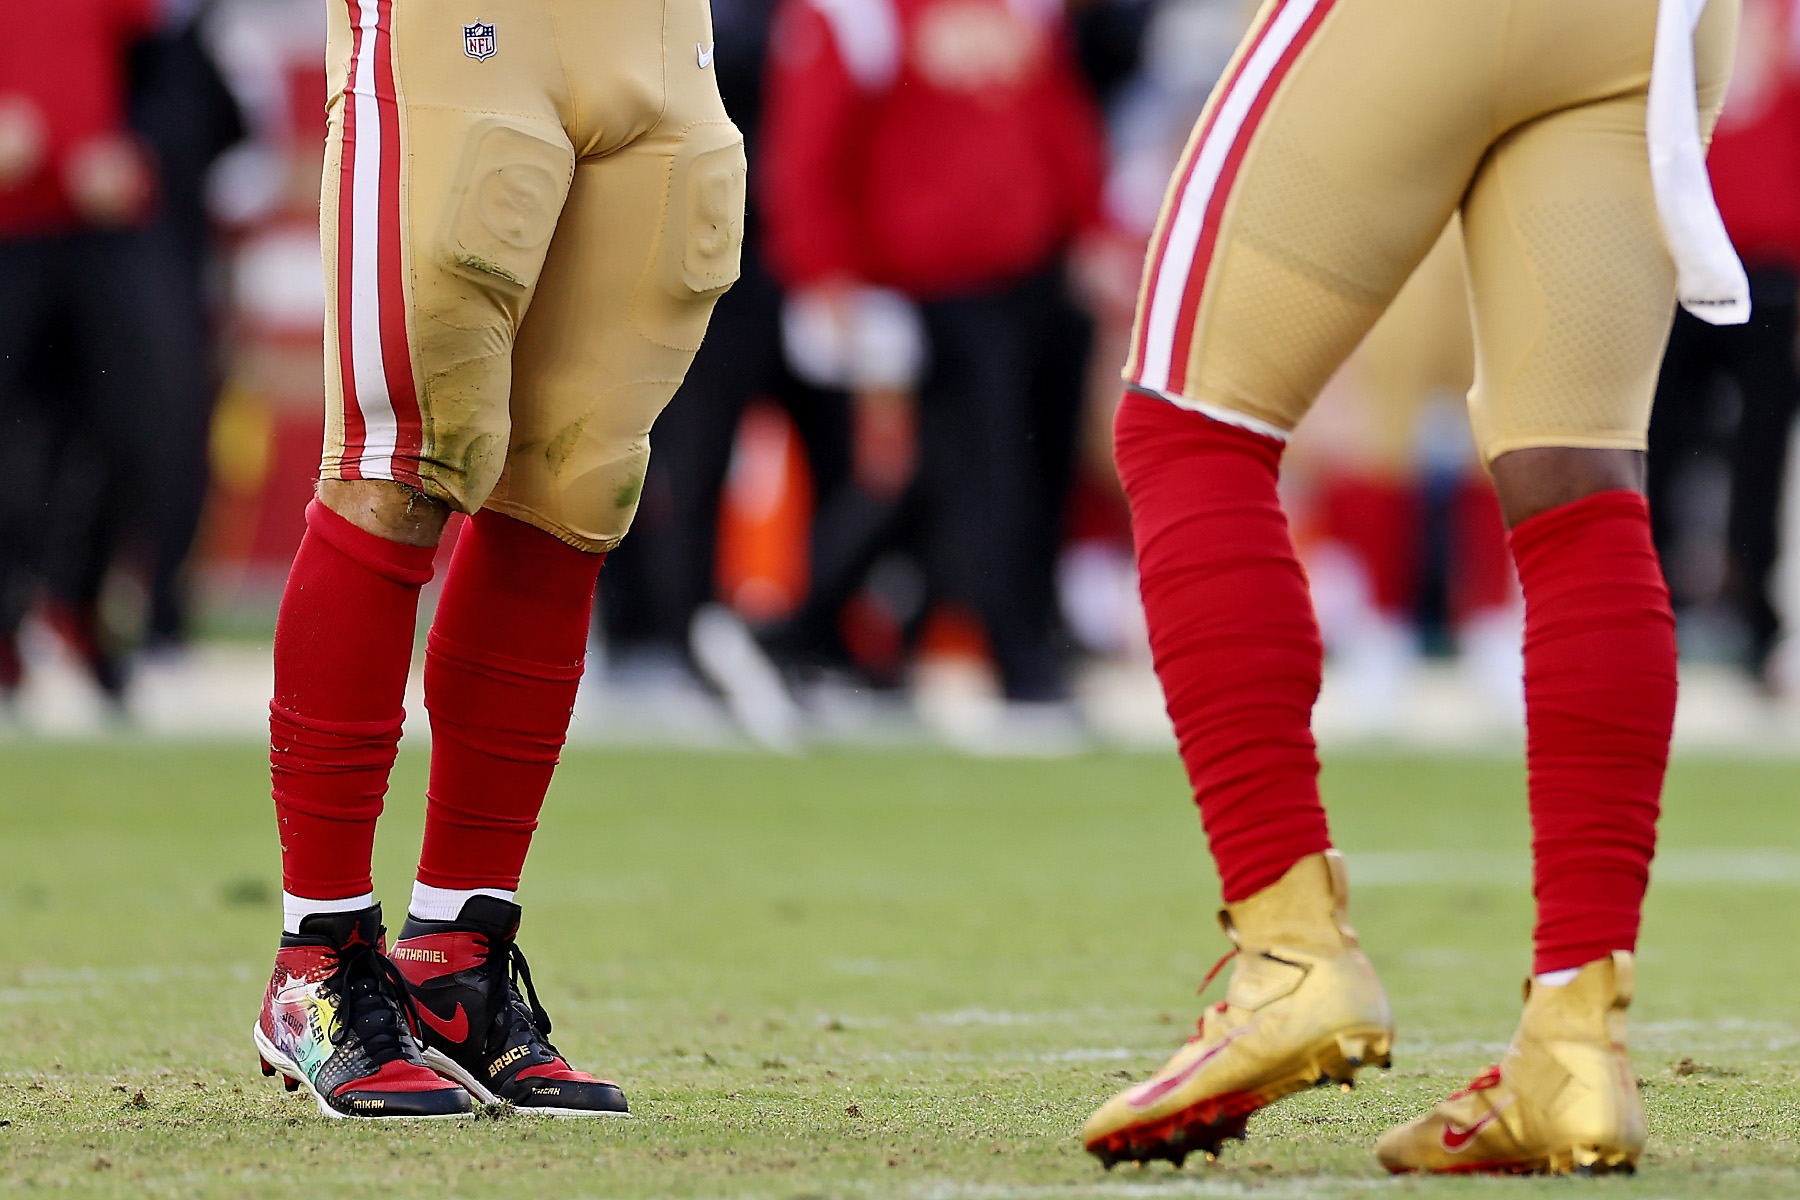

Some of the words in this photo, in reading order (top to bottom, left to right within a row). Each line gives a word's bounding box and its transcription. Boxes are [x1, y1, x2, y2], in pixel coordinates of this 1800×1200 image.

[468, 37, 492, 55] NFL
[394, 947, 449, 963] NATHANIEL
[487, 1044, 532, 1078] BRYCE
[353, 1099, 385, 1110] MIKAH
